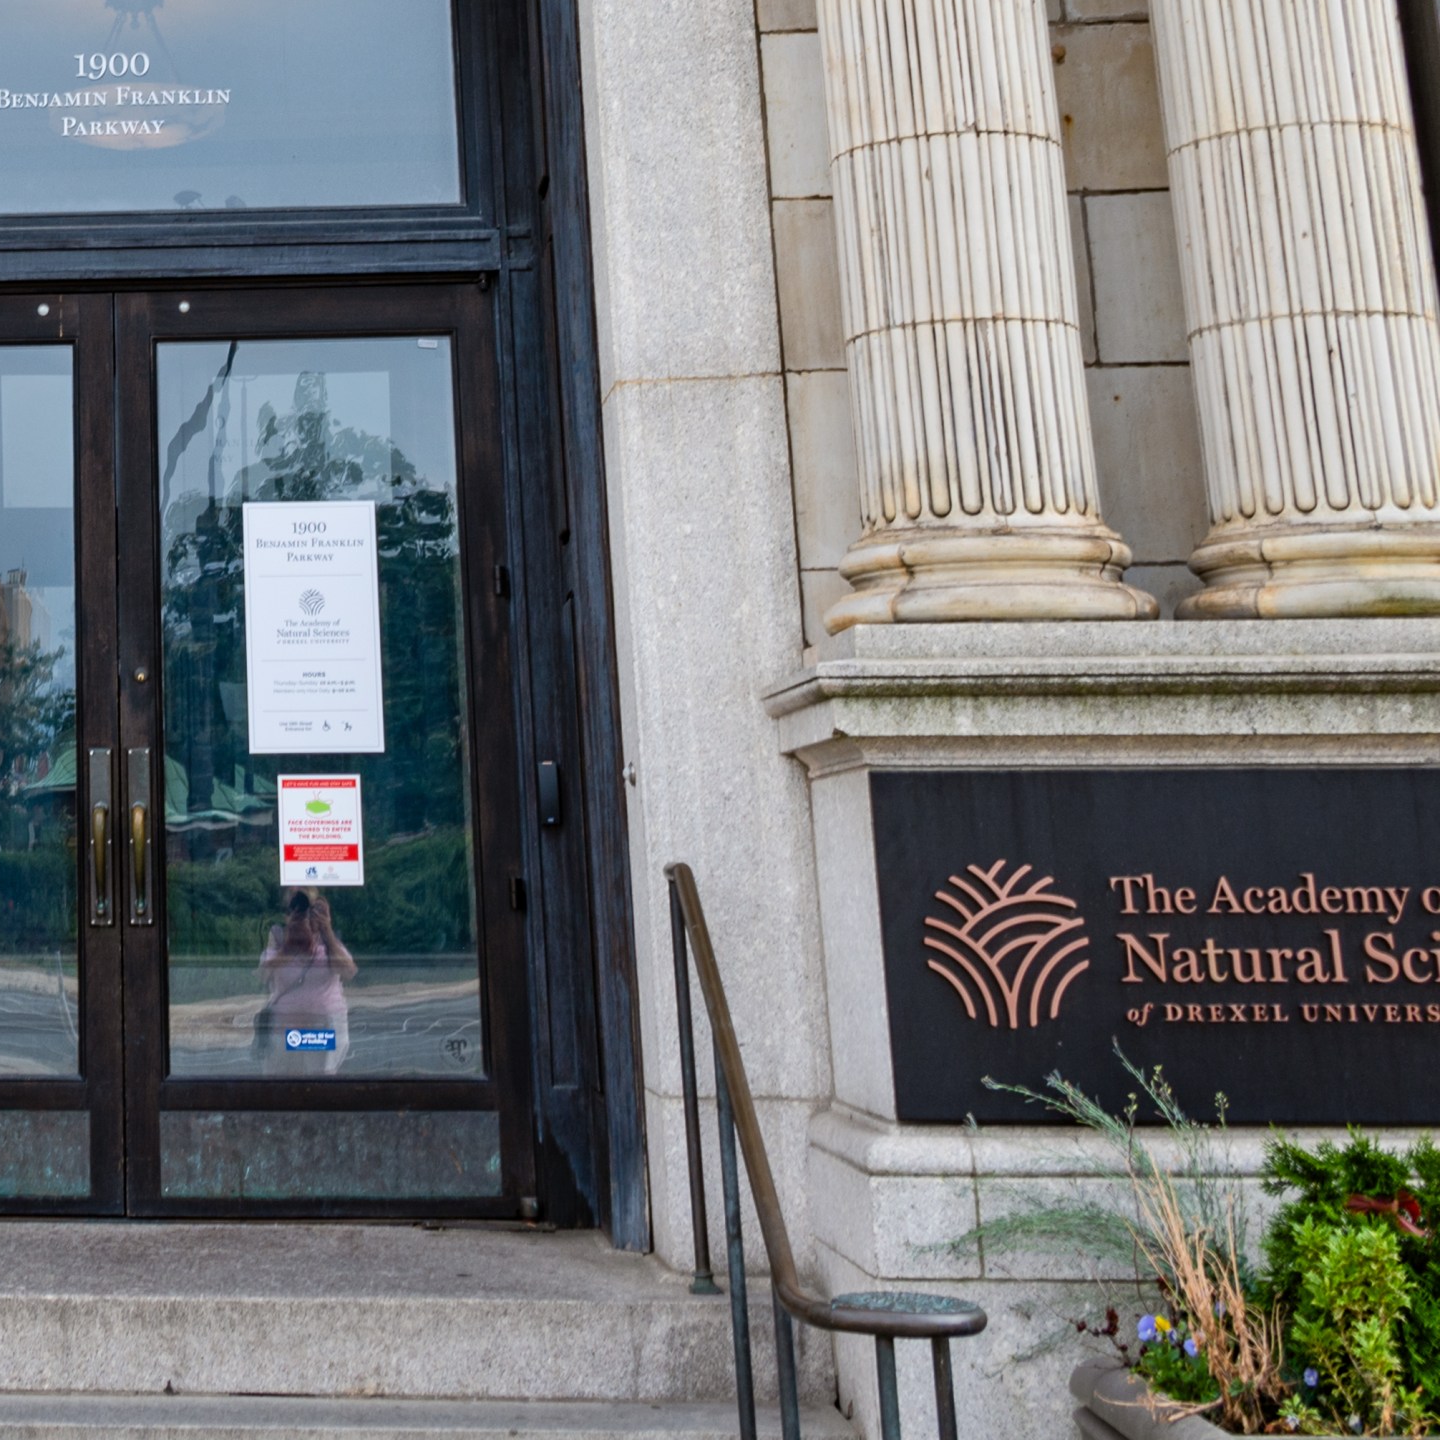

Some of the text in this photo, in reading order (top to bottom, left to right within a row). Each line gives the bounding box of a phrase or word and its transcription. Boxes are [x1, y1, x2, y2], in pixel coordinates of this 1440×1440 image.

[73, 51, 150, 81] 1900
[115, 86, 231, 106] FRANKLIN
[61, 116, 165, 137] PARKWAY
[292, 521, 327, 535] 1900
[277, 628, 350, 638] Natural Sciences
[284, 619, 298, 627] The
[300, 619, 332, 628] Academy
[1110, 873, 1197, 914] The
[1208, 872, 1410, 924] Academy
[1117, 929, 1349, 984] Natural
[1127, 1002, 1153, 1026] of
[1165, 1003, 1289, 1023] DREXEL
